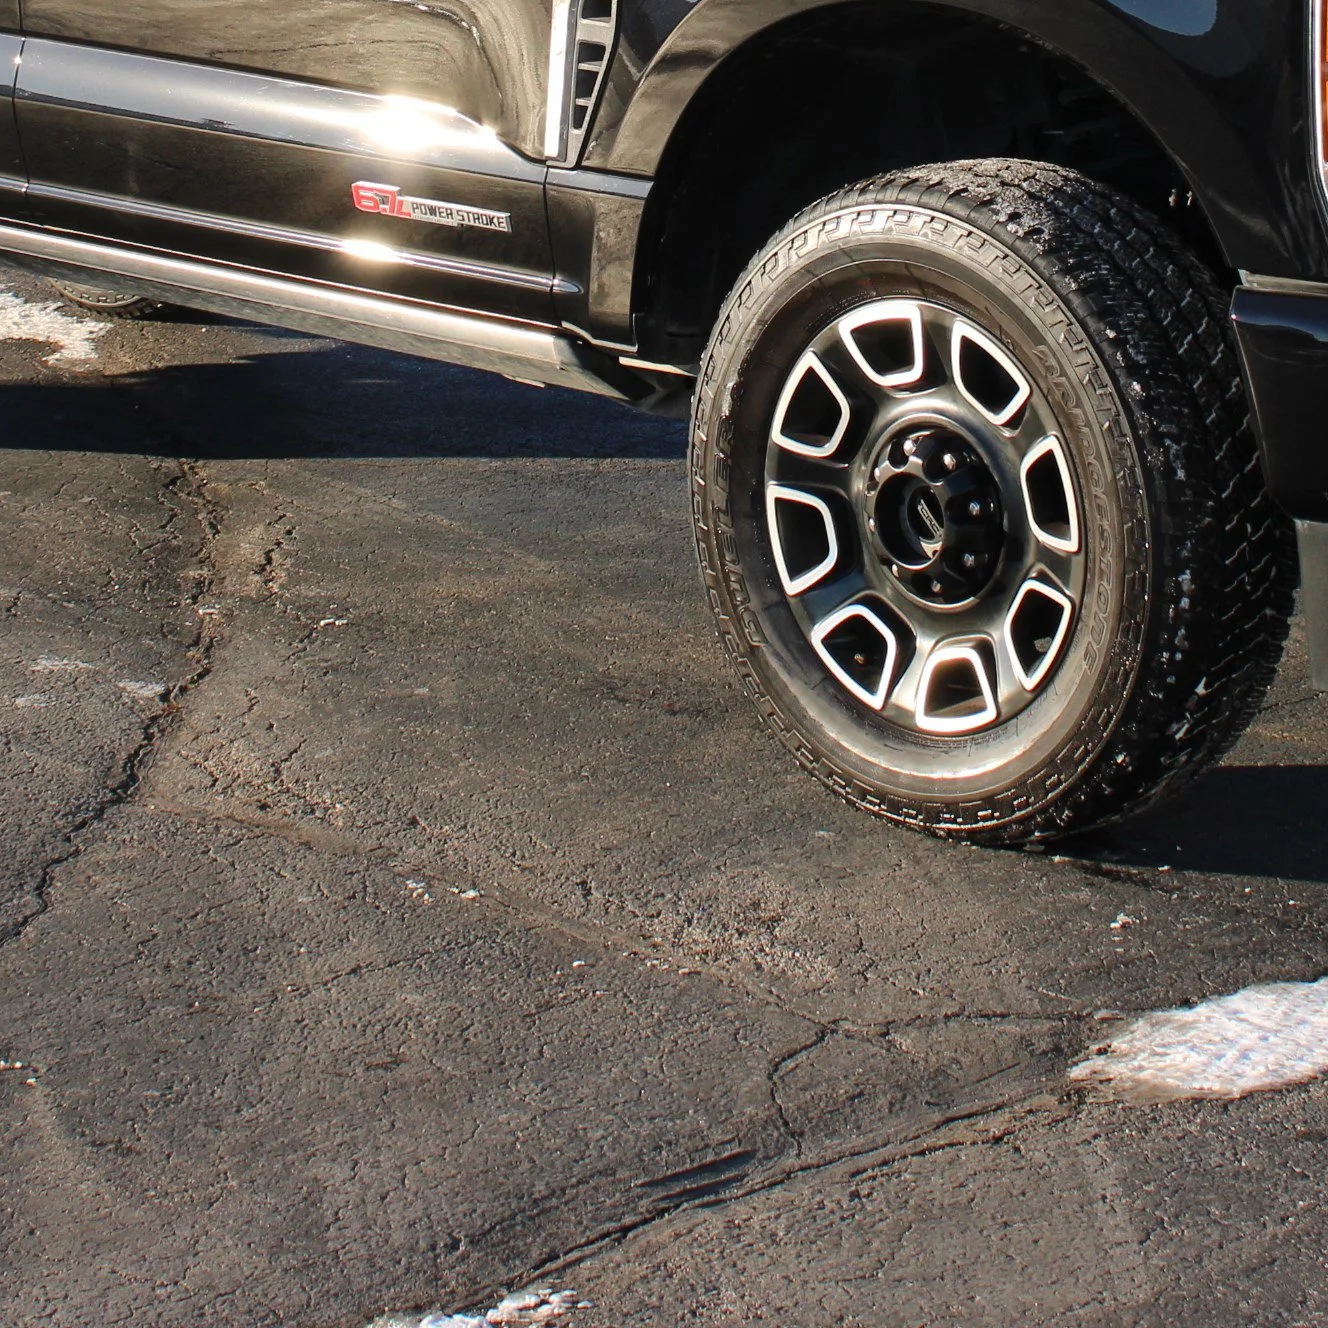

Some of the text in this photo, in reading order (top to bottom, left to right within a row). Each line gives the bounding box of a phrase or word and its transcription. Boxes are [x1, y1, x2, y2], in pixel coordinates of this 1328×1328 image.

[411, 202, 454, 221] POWER
[456, 209, 507, 230] STROKE
[1032, 345, 1112, 675] BRIDGESTONE
